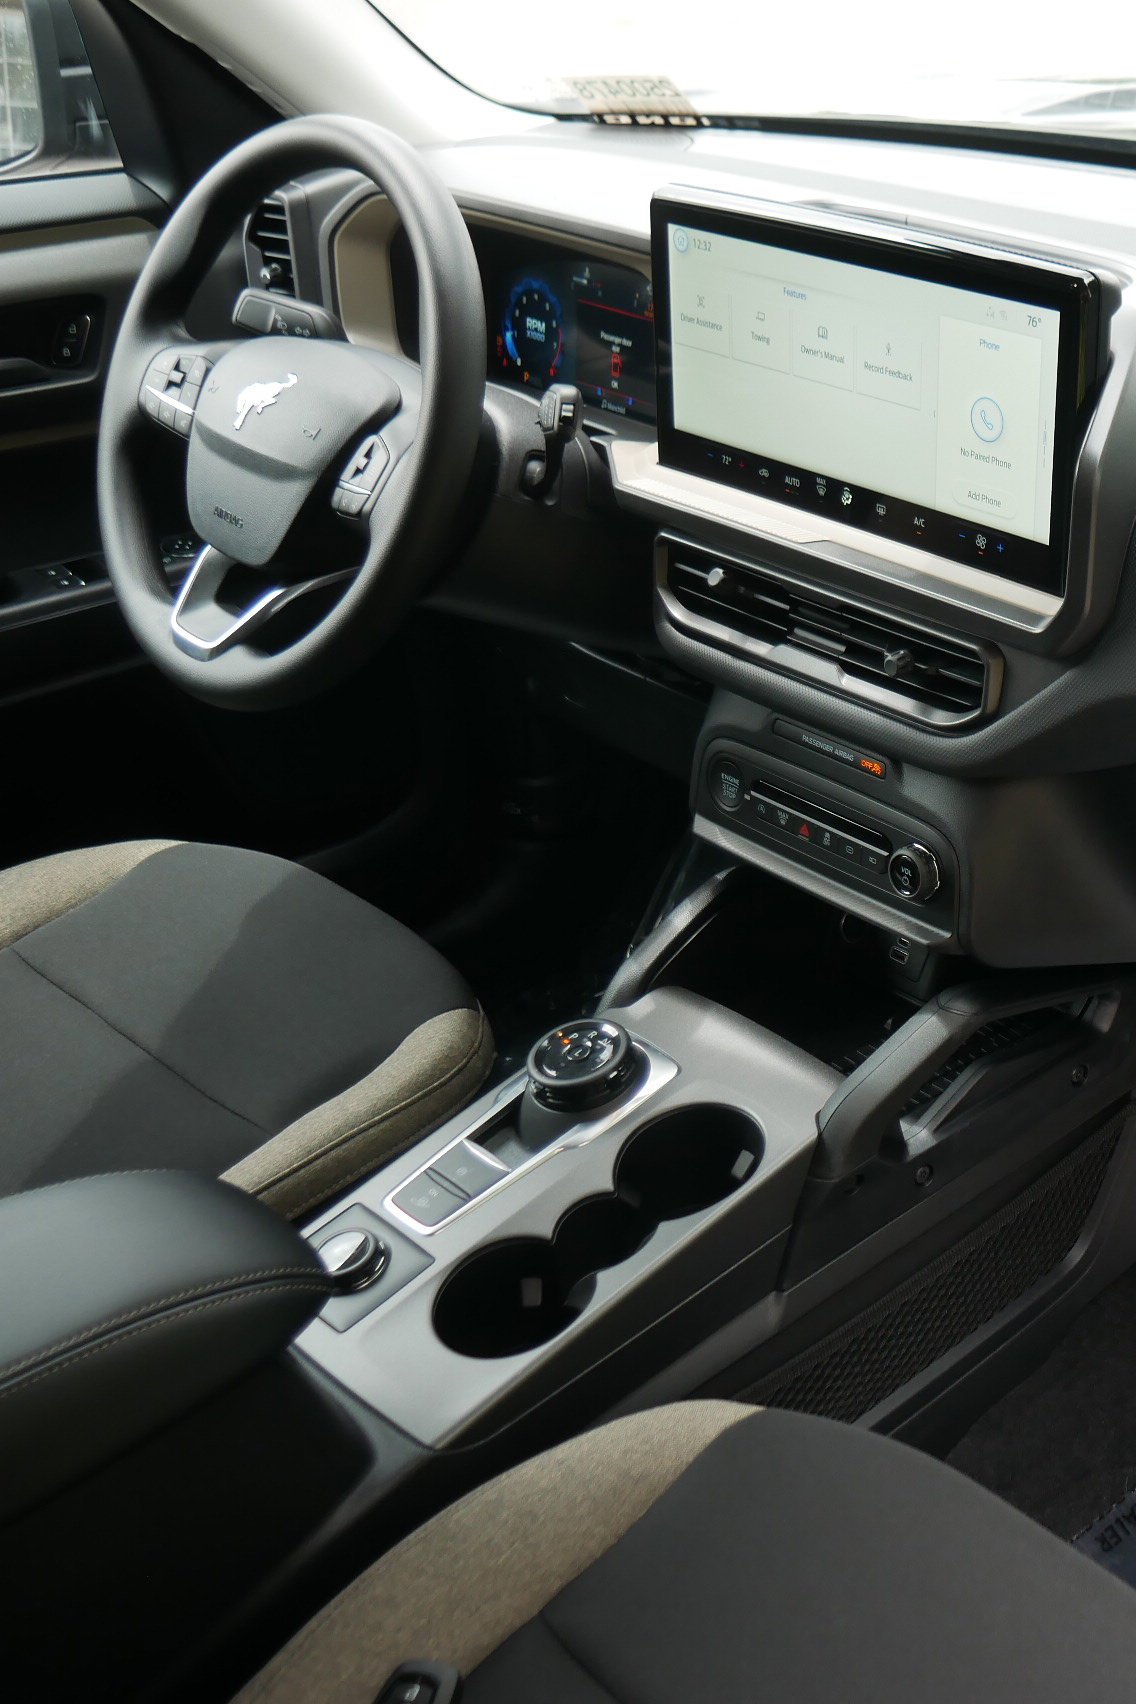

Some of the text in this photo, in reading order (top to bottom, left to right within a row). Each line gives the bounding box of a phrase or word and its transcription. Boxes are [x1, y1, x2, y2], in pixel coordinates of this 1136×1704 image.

[693, 238, 712, 252] 12:32
[783, 287, 807, 300] Features
[526, 316, 546, 333] RPM
[680, 313, 723, 332] Driver Assistance
[1027, 315, 1043, 328] 76°
[751, 331, 771, 346] Towing
[979, 338, 1000, 352] Phone
[801, 345, 845, 364] Owner's Manual
[864, 361, 913, 383] Record Feedback
[960, 447, 1012, 470] No Paired Phone
[784, 476, 801, 488] AUTO
[816, 477, 827, 486] MAX
[967, 490, 1002, 508] Add Phone
[914, 516, 926, 528] A/C
[802, 734, 834, 752] PASSENGER
[834, 748, 855, 761] AIRBAG
[721, 773, 740, 785] ENGINE
[723, 784, 738, 793] START
[723, 789, 736, 799] STOP
[901, 867, 912, 877] VOL
[569, 1033, 578, 1041] P
